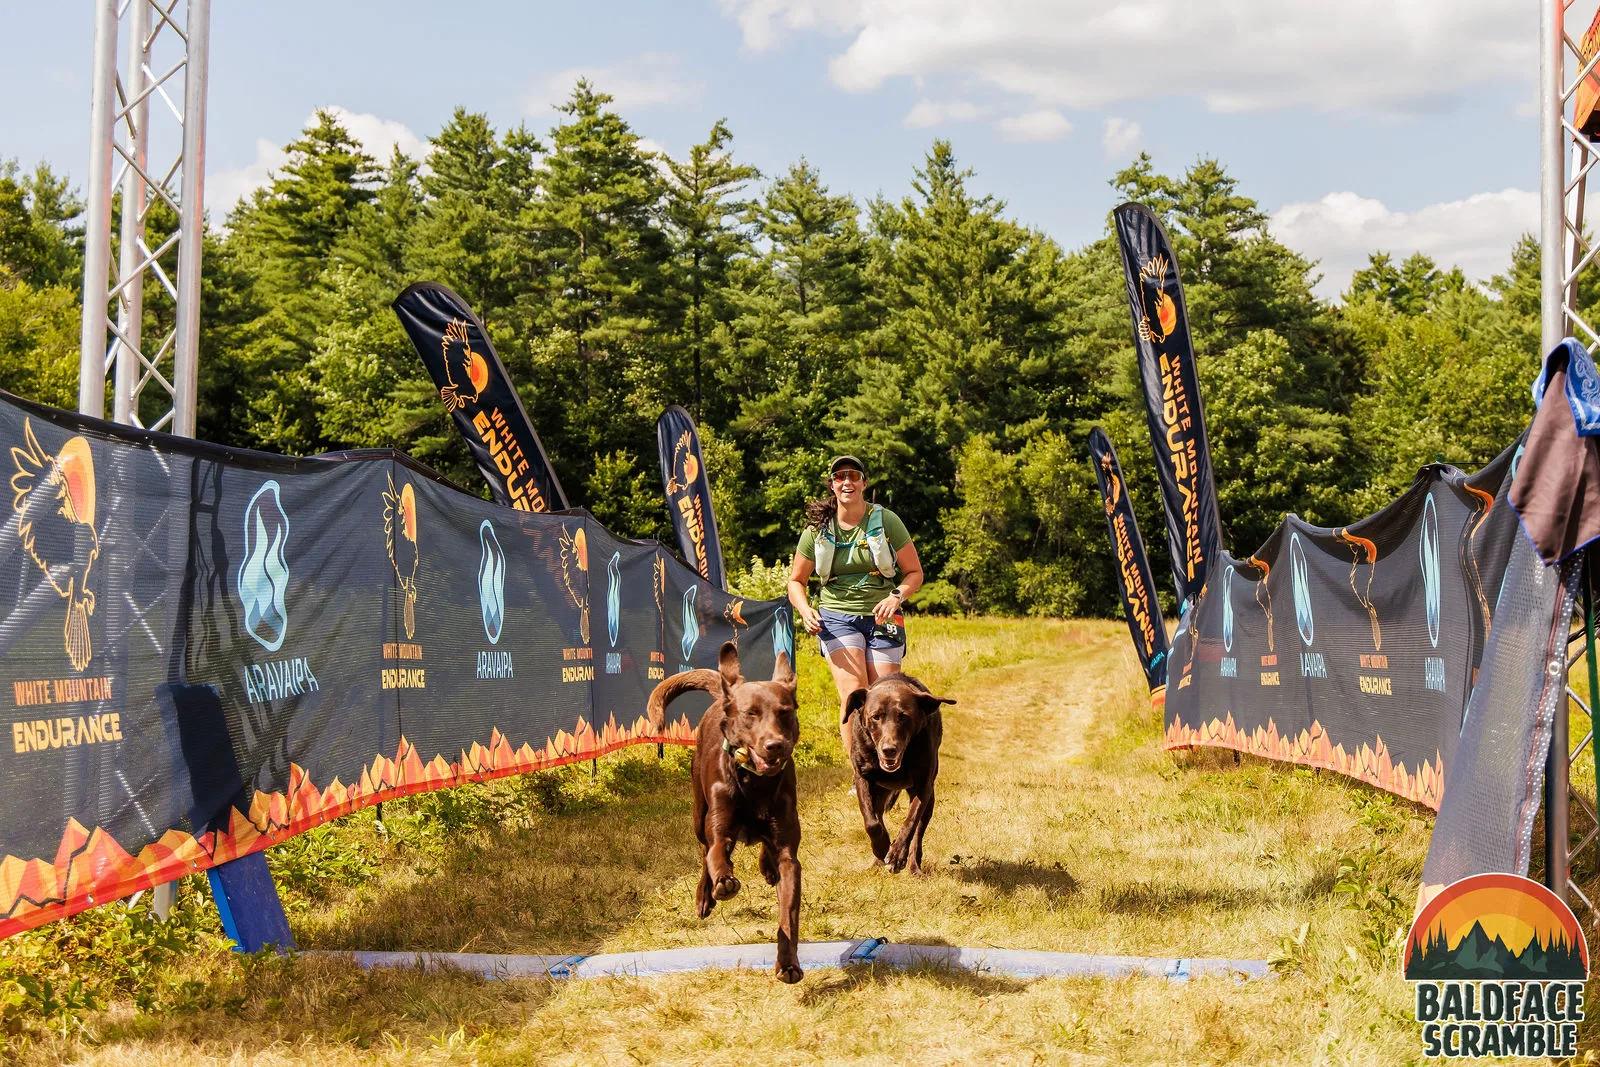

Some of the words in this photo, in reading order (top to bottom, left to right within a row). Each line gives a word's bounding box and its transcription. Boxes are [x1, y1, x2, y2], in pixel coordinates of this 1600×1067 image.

[1171, 355, 1192, 431] WHITE
[491, 406, 530, 476] WHITE
[525, 478, 551, 513] MO
[886, 623, 898, 635] 93
[244, 657, 320, 703] ARAVAIPA
[381, 669, 425, 690] ENDURANCE
[476, 651, 514, 679] ARAVAIPA
[14, 680, 51, 706] WHITE
[54, 678, 112, 703] MOUNTAIN
[13, 713, 123, 753] ENDURANCE
